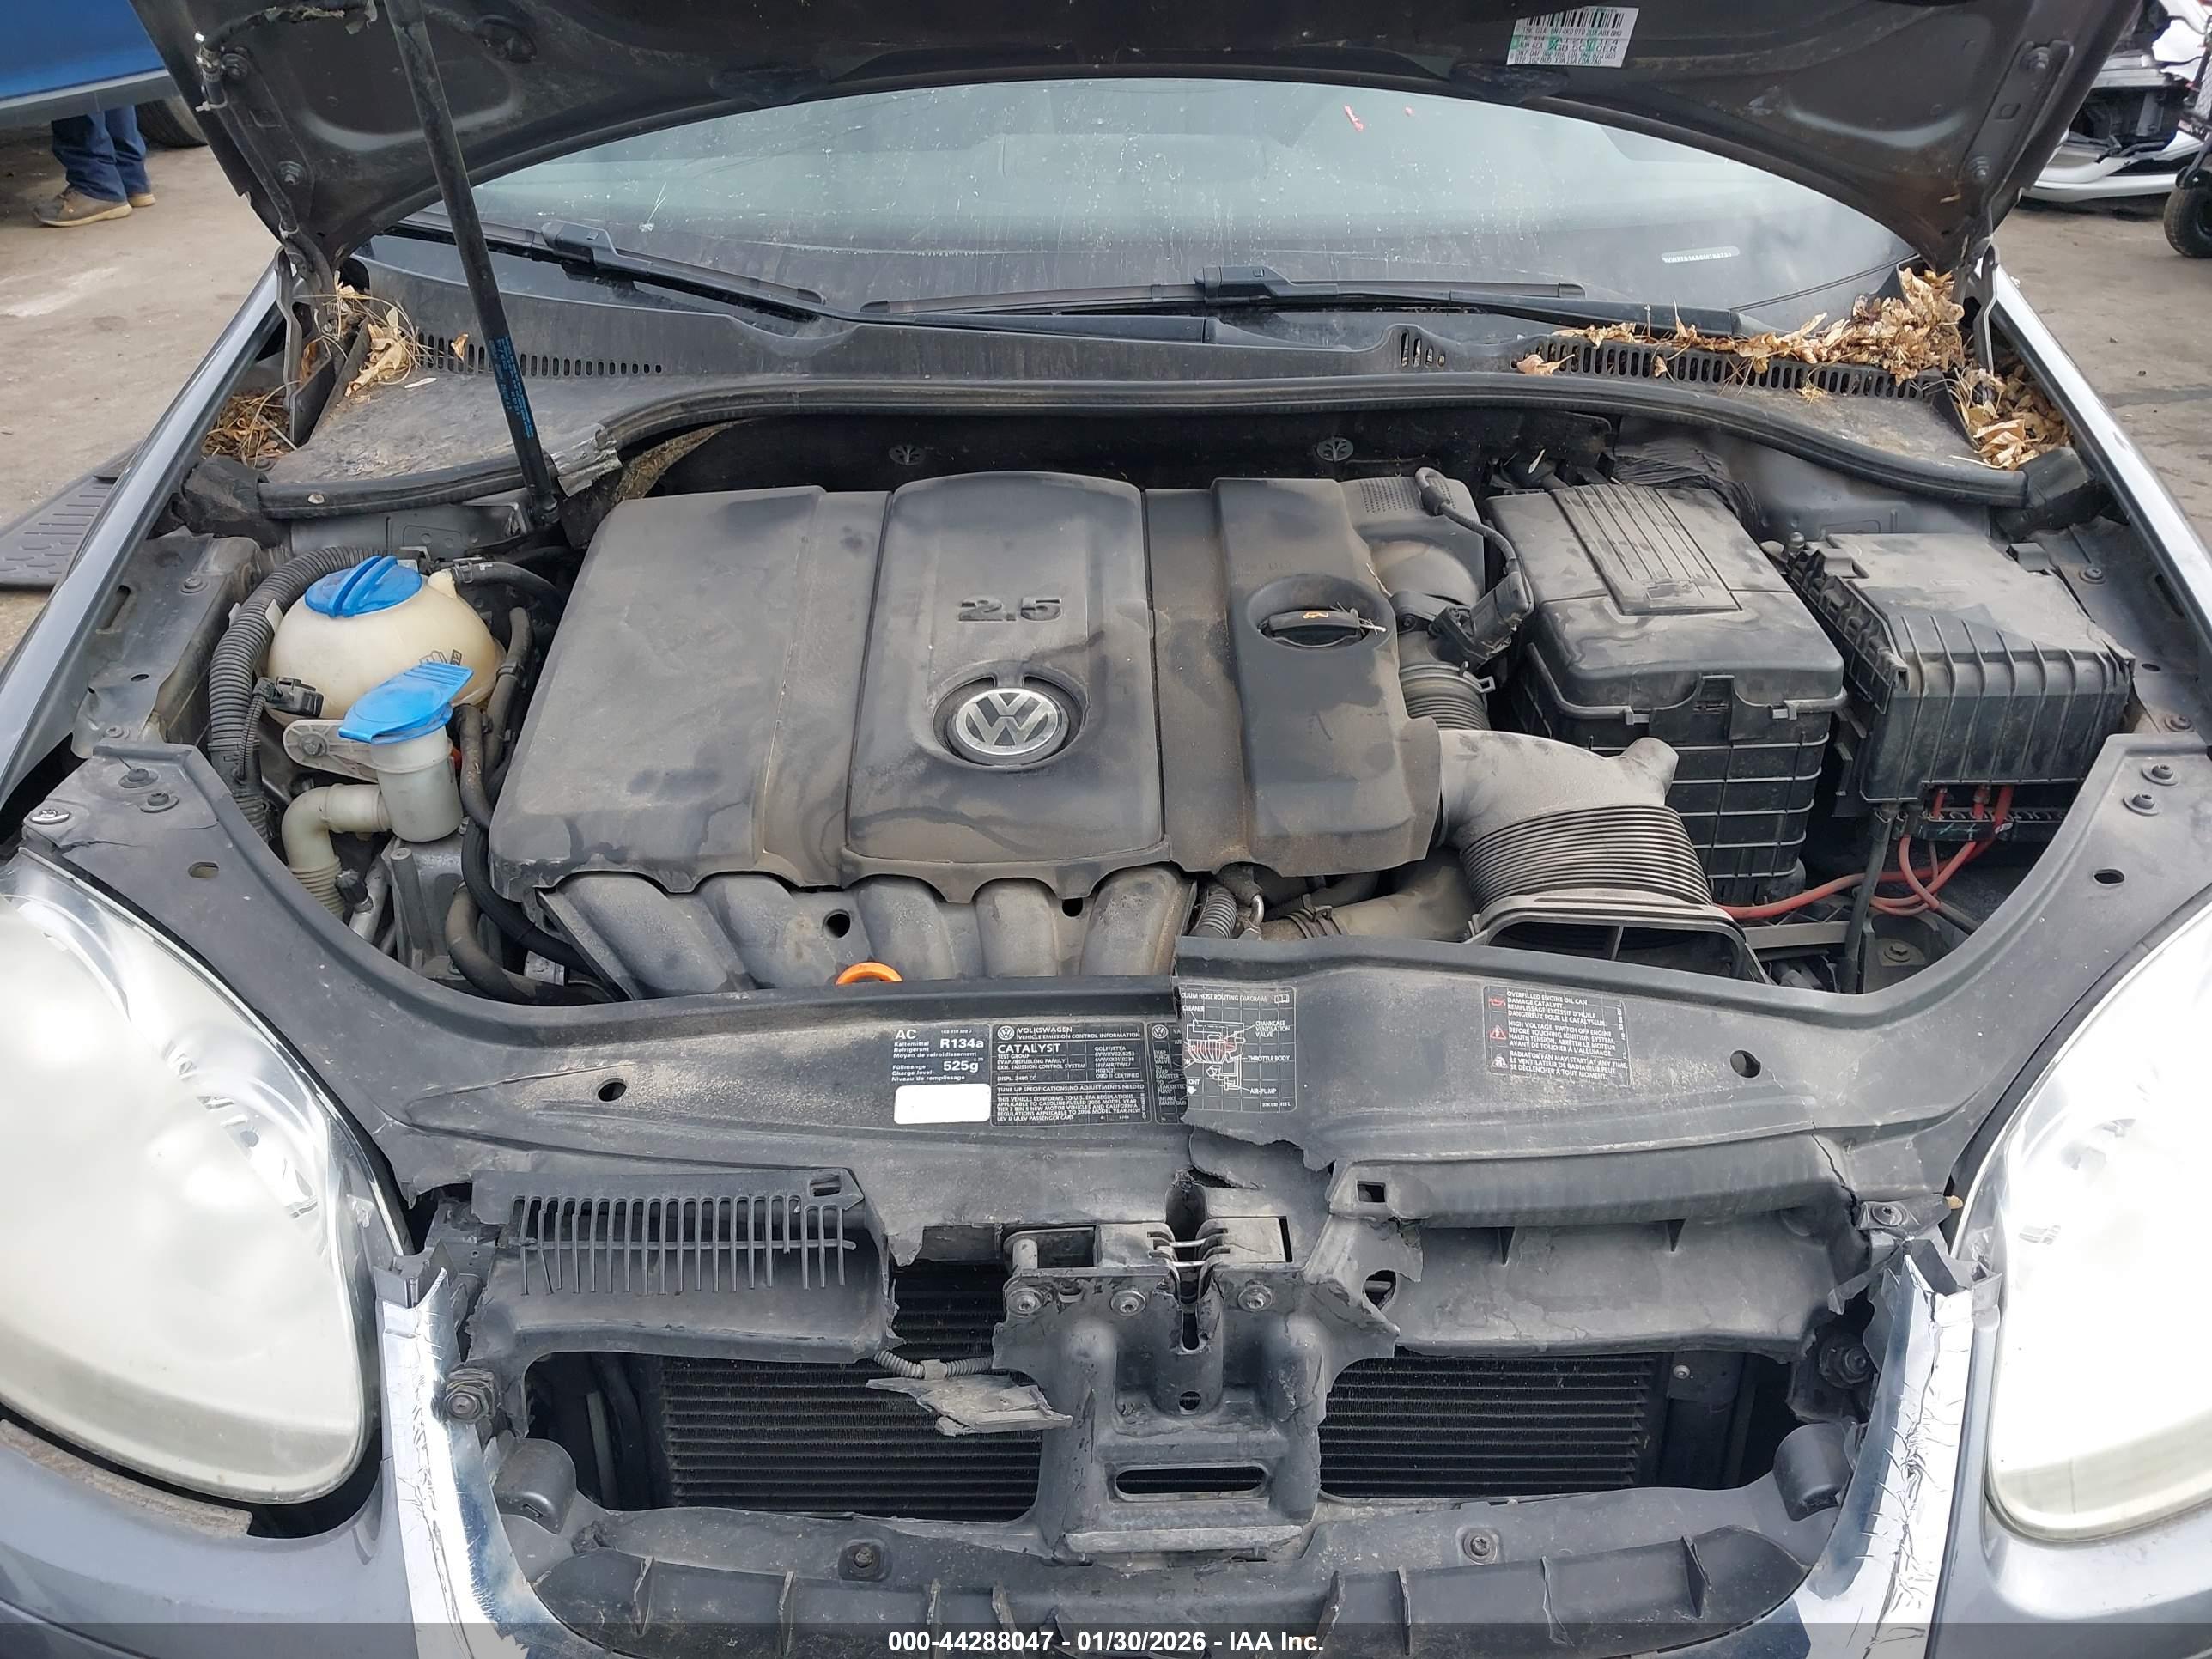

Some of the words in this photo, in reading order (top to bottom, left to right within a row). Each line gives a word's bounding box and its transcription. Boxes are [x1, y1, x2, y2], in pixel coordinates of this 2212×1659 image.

[958, 597, 1061, 622] 2.5
[1507, 991, 1540, 1000] OVERFILLED
[1508, 1004, 1546, 1013] REMPLISSAGE
[1508, 1010, 1544, 1018] DANGEREUX
[895, 1029, 917, 1040] AC
[1530, 1030, 1562, 1038] TOUCHING
[940, 1038, 984, 1048] R134a
[1592, 1042, 1616, 1051] MOTEUR
[998, 1043, 1061, 1053] CATALYST
[1510, 1051, 1539, 1060] RADIATOR
[944, 1061, 979, 1073] 525g
[1518, 1058, 1556, 1067] VENTILATEUR
[1567, 1063, 1601, 1072] RADIATEUR
